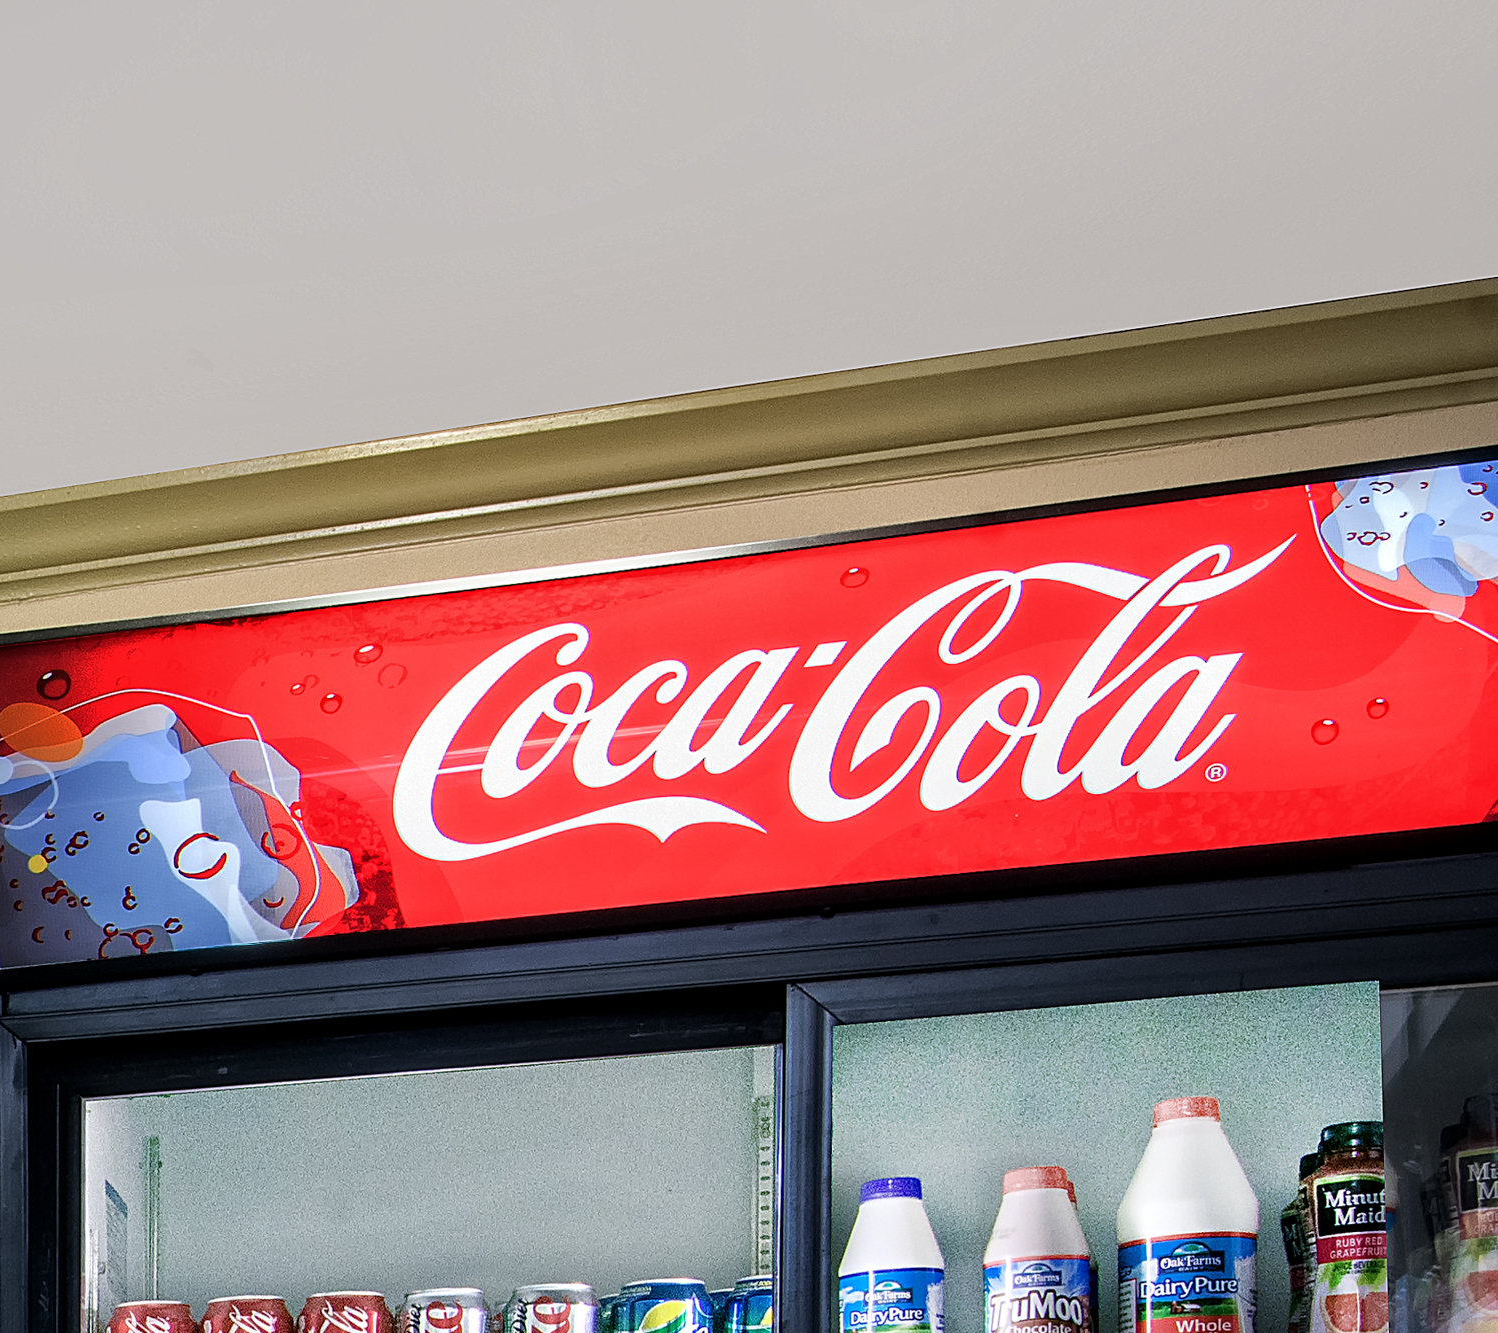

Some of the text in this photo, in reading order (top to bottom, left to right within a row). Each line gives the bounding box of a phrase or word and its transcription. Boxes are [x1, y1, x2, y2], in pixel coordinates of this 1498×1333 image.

[393, 533, 1296, 863] Coca-Cola
[1336, 1236, 1383, 1248] RUBY RED
[1139, 1277, 1238, 1299] DairyPure
[989, 1291, 1083, 1332] TruMoo
[1175, 1318, 1232, 1333] Whole
